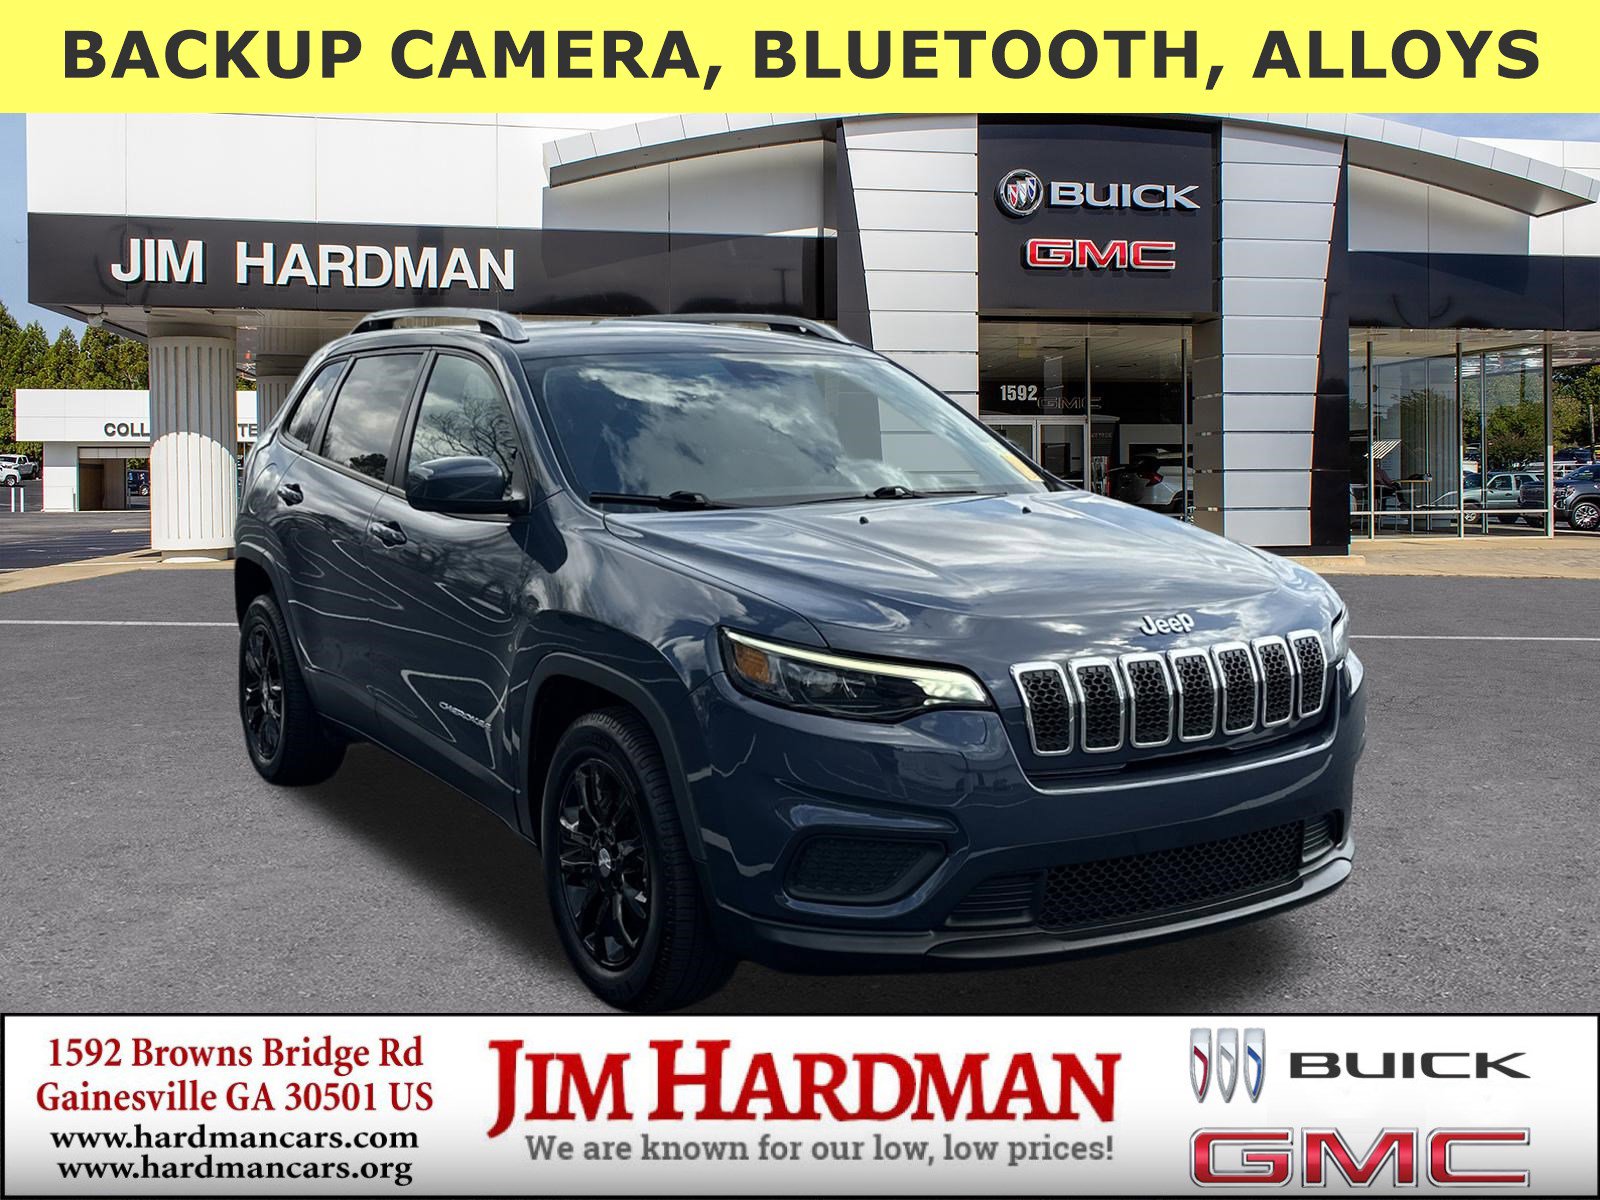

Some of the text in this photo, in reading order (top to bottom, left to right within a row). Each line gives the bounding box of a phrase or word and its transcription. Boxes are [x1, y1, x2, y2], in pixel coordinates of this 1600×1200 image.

[1050, 181, 1200, 210] BUICK
[111, 238, 515, 290] JIM HARDMAN
[1025, 238, 1177, 270] GMC
[1000, 384, 1038, 401] 1592
[1037, 397, 1102, 409] GMC
[1140, 612, 1195, 636] Jeep
